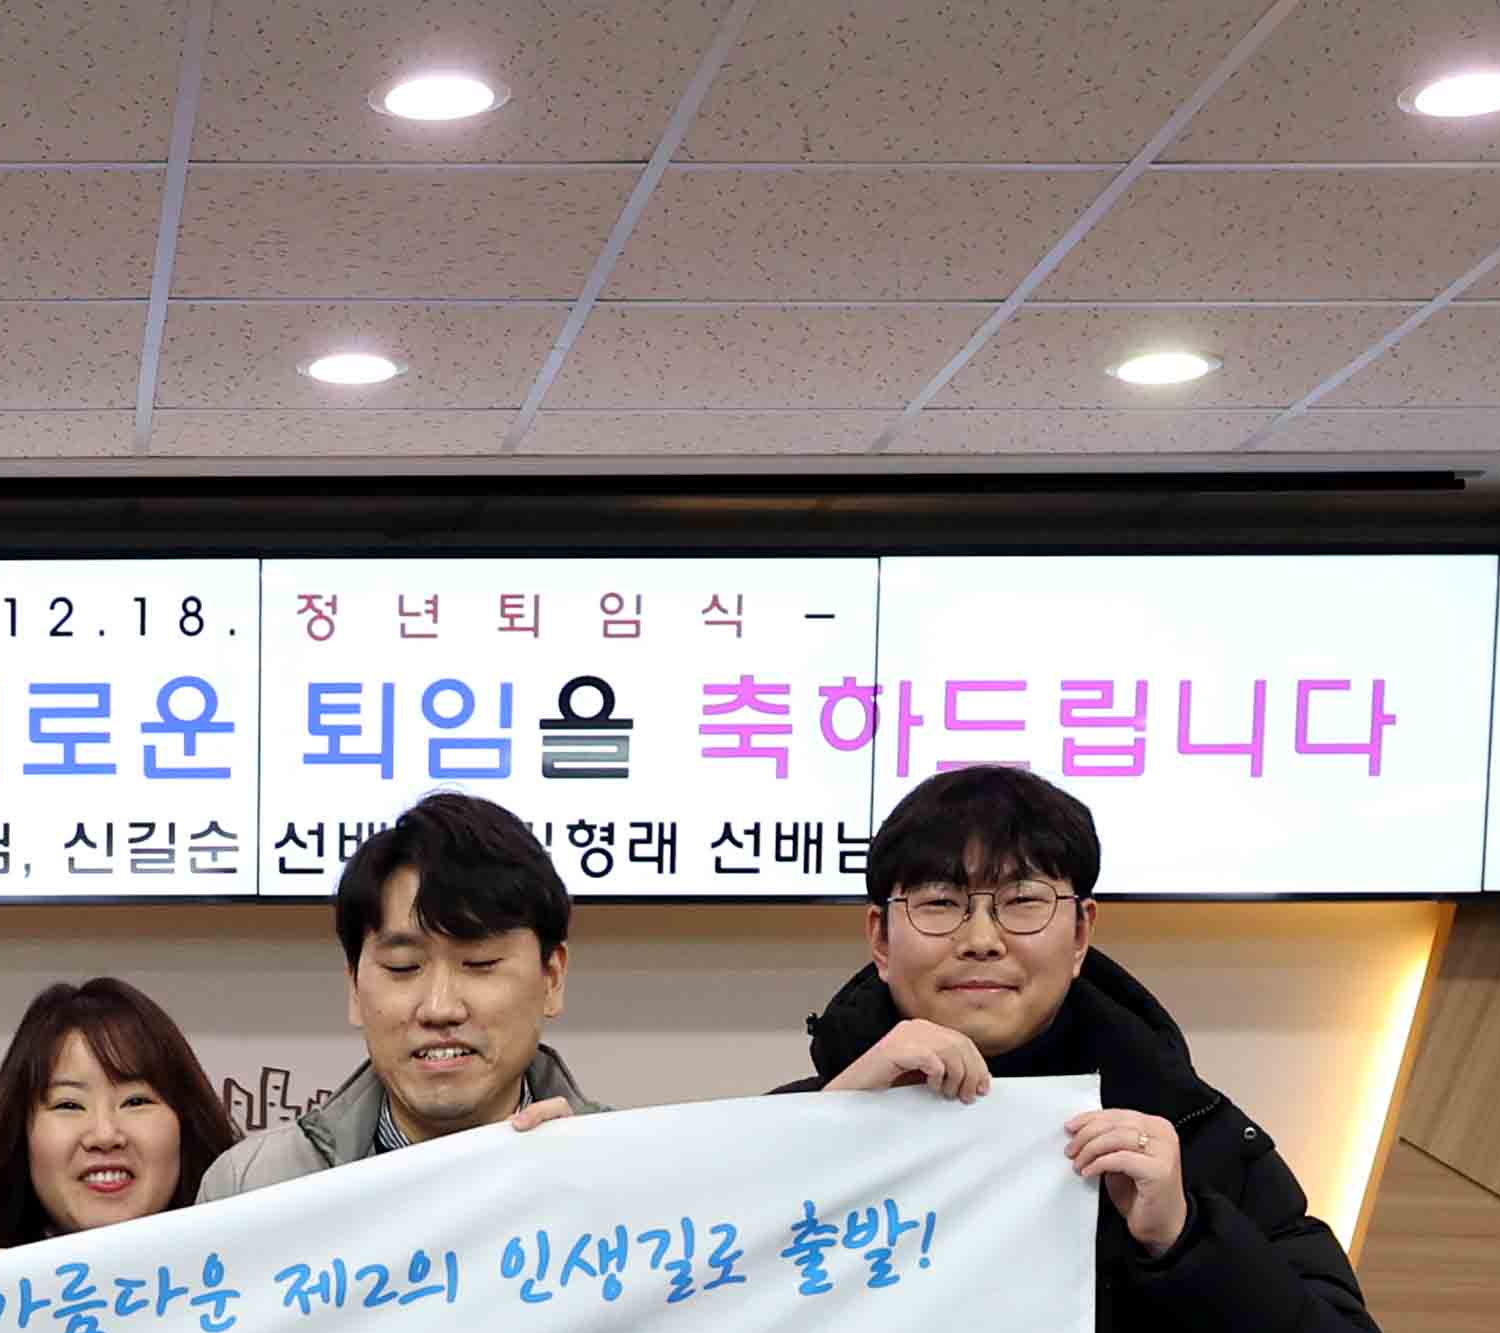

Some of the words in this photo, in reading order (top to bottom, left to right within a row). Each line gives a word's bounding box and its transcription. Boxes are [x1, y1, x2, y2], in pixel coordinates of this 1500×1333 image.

[301, 674, 636, 784] 퇴임을
[698, 674, 1399, 782] 축하드립니다
[63, 819, 240, 878] 신길순
[524, 818, 678, 880] 형래
[272, 1248, 464, 1316] 제2의
[499, 1214, 748, 1307] 인생길로
[778, 1197, 940, 1298] 출발!
